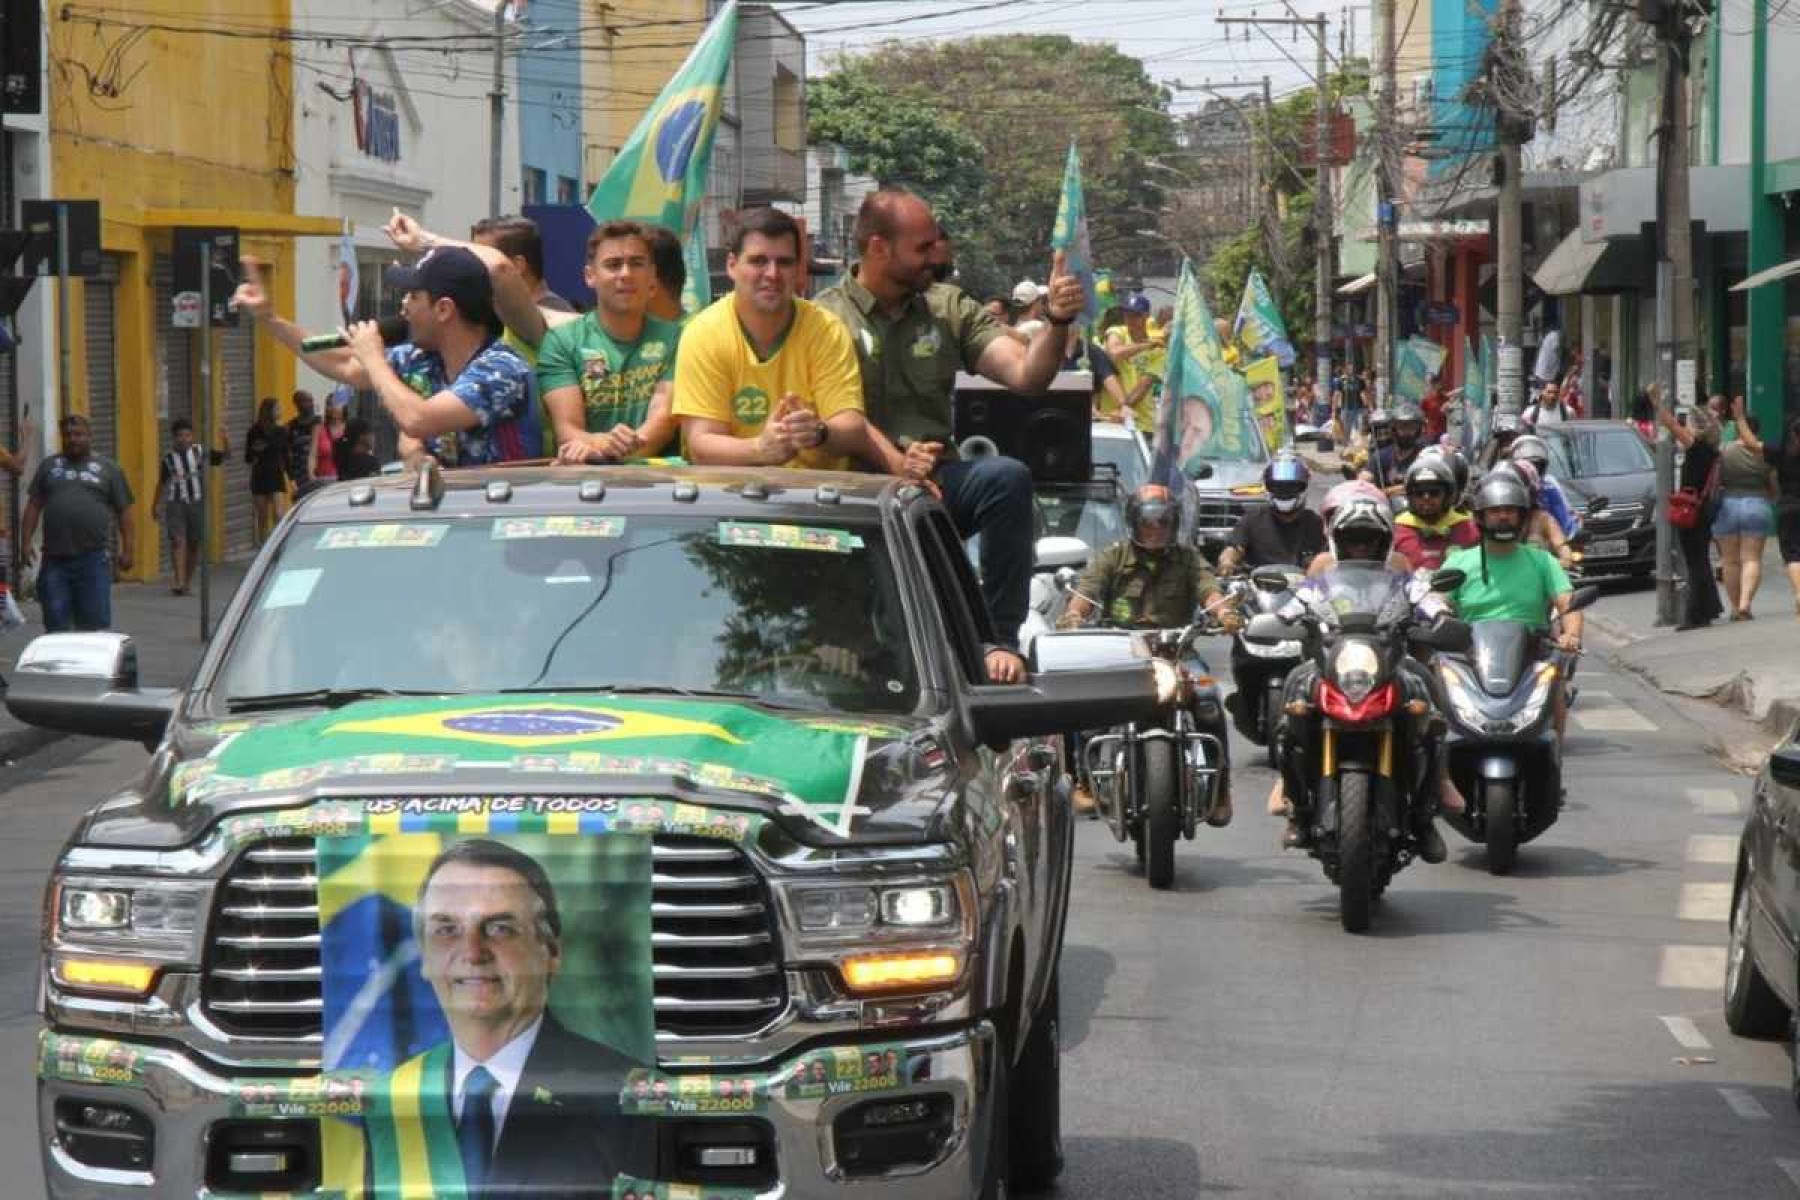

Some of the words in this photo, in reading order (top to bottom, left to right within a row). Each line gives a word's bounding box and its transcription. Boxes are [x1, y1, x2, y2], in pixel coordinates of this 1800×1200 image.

[736, 397, 767, 415] 22
[404, 797, 482, 813] ACIMA
[490, 798, 525, 812] DE
[531, 798, 619, 813] TODOS
[95, 1066, 132, 1082] 22000
[828, 1079, 853, 1094] Vile
[278, 1102, 306, 1115] Vile
[307, 1101, 362, 1115] 22000
[669, 1099, 697, 1112] Vile
[697, 1098, 755, 1111] 22000
